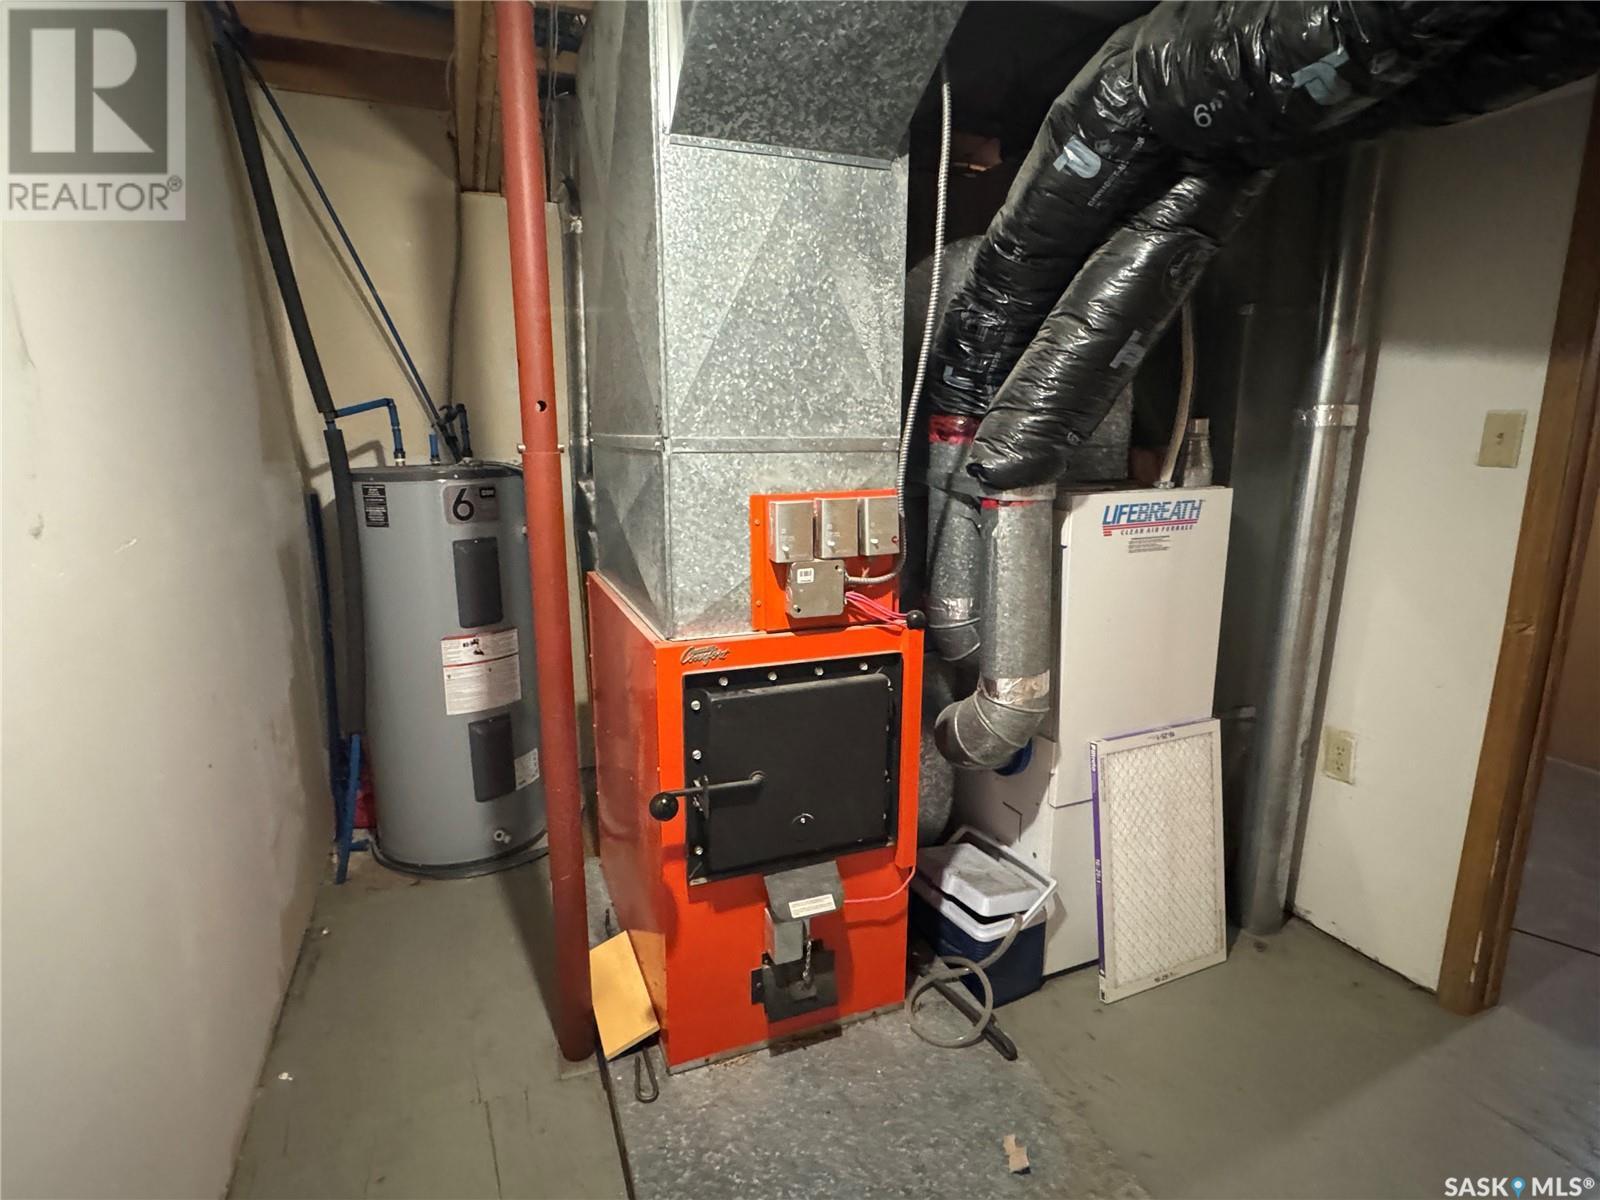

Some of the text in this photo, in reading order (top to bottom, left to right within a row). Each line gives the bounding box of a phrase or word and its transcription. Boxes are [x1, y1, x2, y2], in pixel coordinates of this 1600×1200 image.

[452, 487, 475, 522] 6
[1103, 500, 1202, 525] LIFEBREATH
[1120, 524, 1194, 536] CLEAN AIR FURNACE
